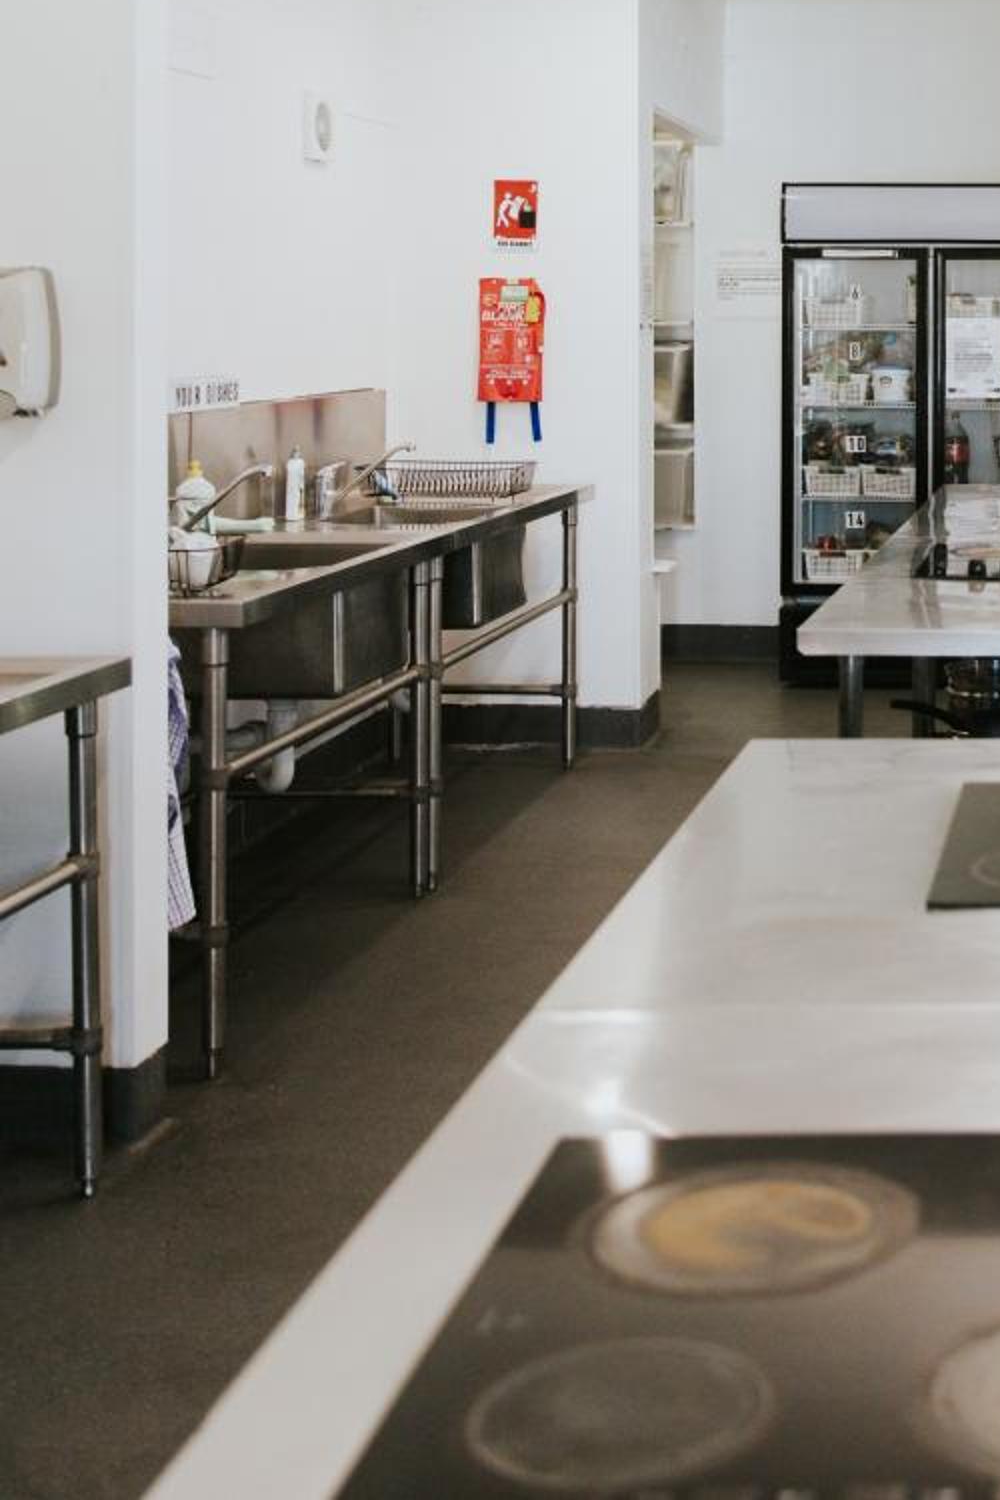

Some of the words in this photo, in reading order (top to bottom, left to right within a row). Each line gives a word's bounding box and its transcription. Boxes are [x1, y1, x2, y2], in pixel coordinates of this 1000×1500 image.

[851, 343, 858, 358] 8
[849, 437, 865, 451] 10
[848, 513, 863, 527] 14
